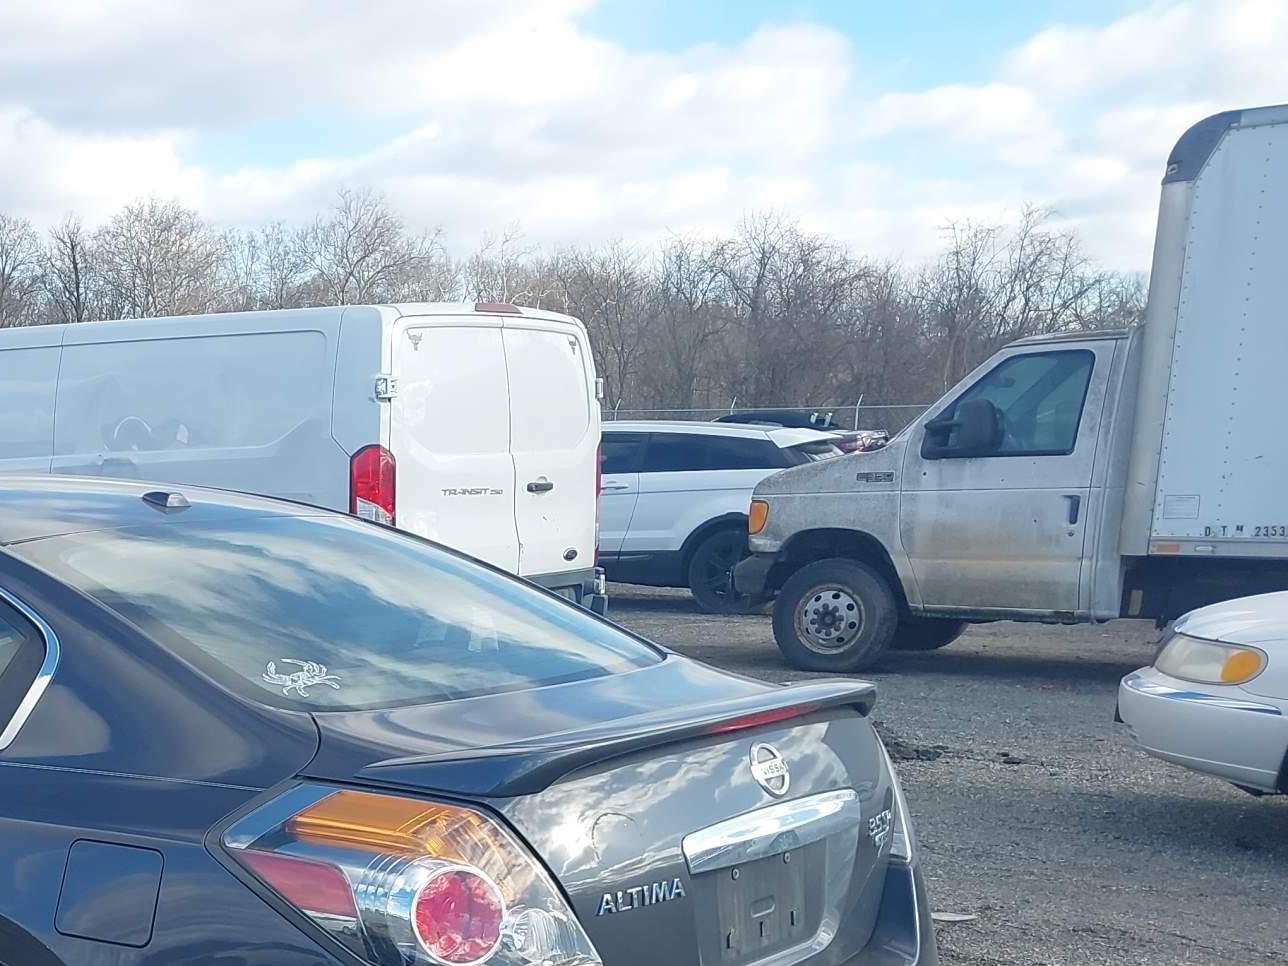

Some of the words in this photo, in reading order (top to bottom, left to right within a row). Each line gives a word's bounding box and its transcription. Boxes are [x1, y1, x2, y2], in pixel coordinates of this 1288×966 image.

[441, 487, 490, 496] TRANSIT
[1254, 525, 1288, 537] 2353
[594, 877, 686, 917] ALTIMA
